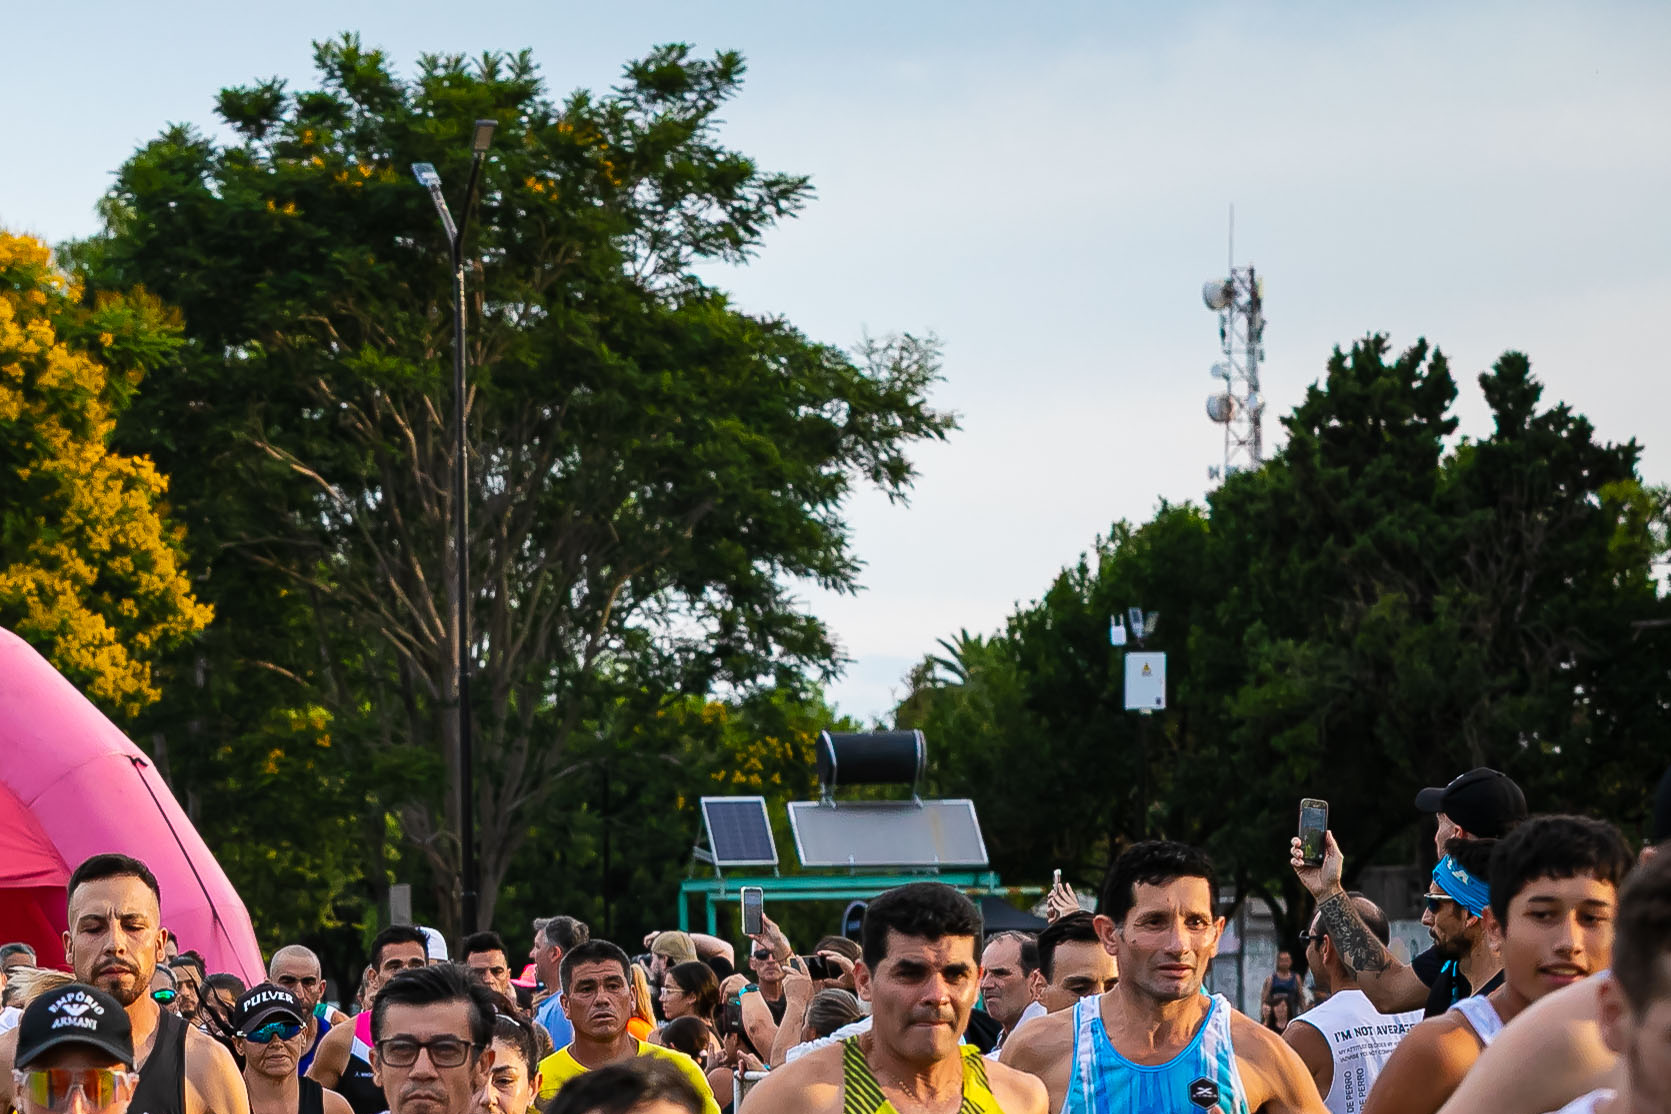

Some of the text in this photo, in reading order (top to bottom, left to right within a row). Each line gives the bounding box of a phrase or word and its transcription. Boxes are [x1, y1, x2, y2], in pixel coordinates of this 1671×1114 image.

[243, 990, 294, 1013] PULVER
[1333, 1029, 1353, 1043] I'M
[1354, 1026, 1374, 1037] NOT
